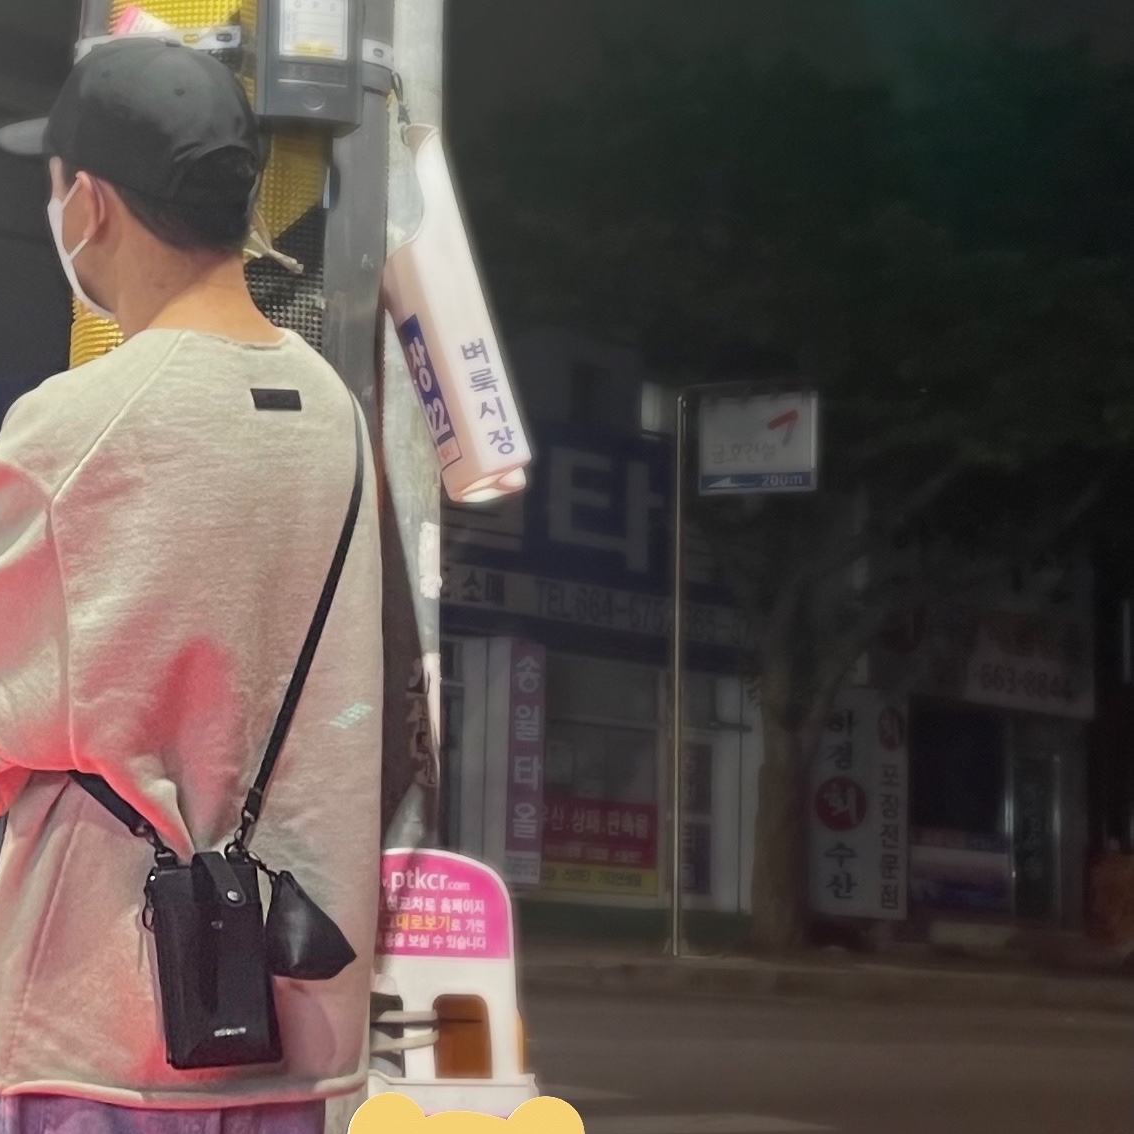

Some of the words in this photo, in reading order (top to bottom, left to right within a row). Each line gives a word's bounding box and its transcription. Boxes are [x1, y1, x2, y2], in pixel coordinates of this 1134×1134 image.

[459, 337, 515, 456] 벼룩시장
[761, 474, 804, 487] 200m
[511, 653, 542, 840] 송월타올
[878, 763, 901, 911] 포장전문점
[440, 897, 485, 915] 홈페이지
[408, 933, 430, 949] 보실
[432, 934, 444, 949] 수
[446, 935, 486, 951] 있습니다
